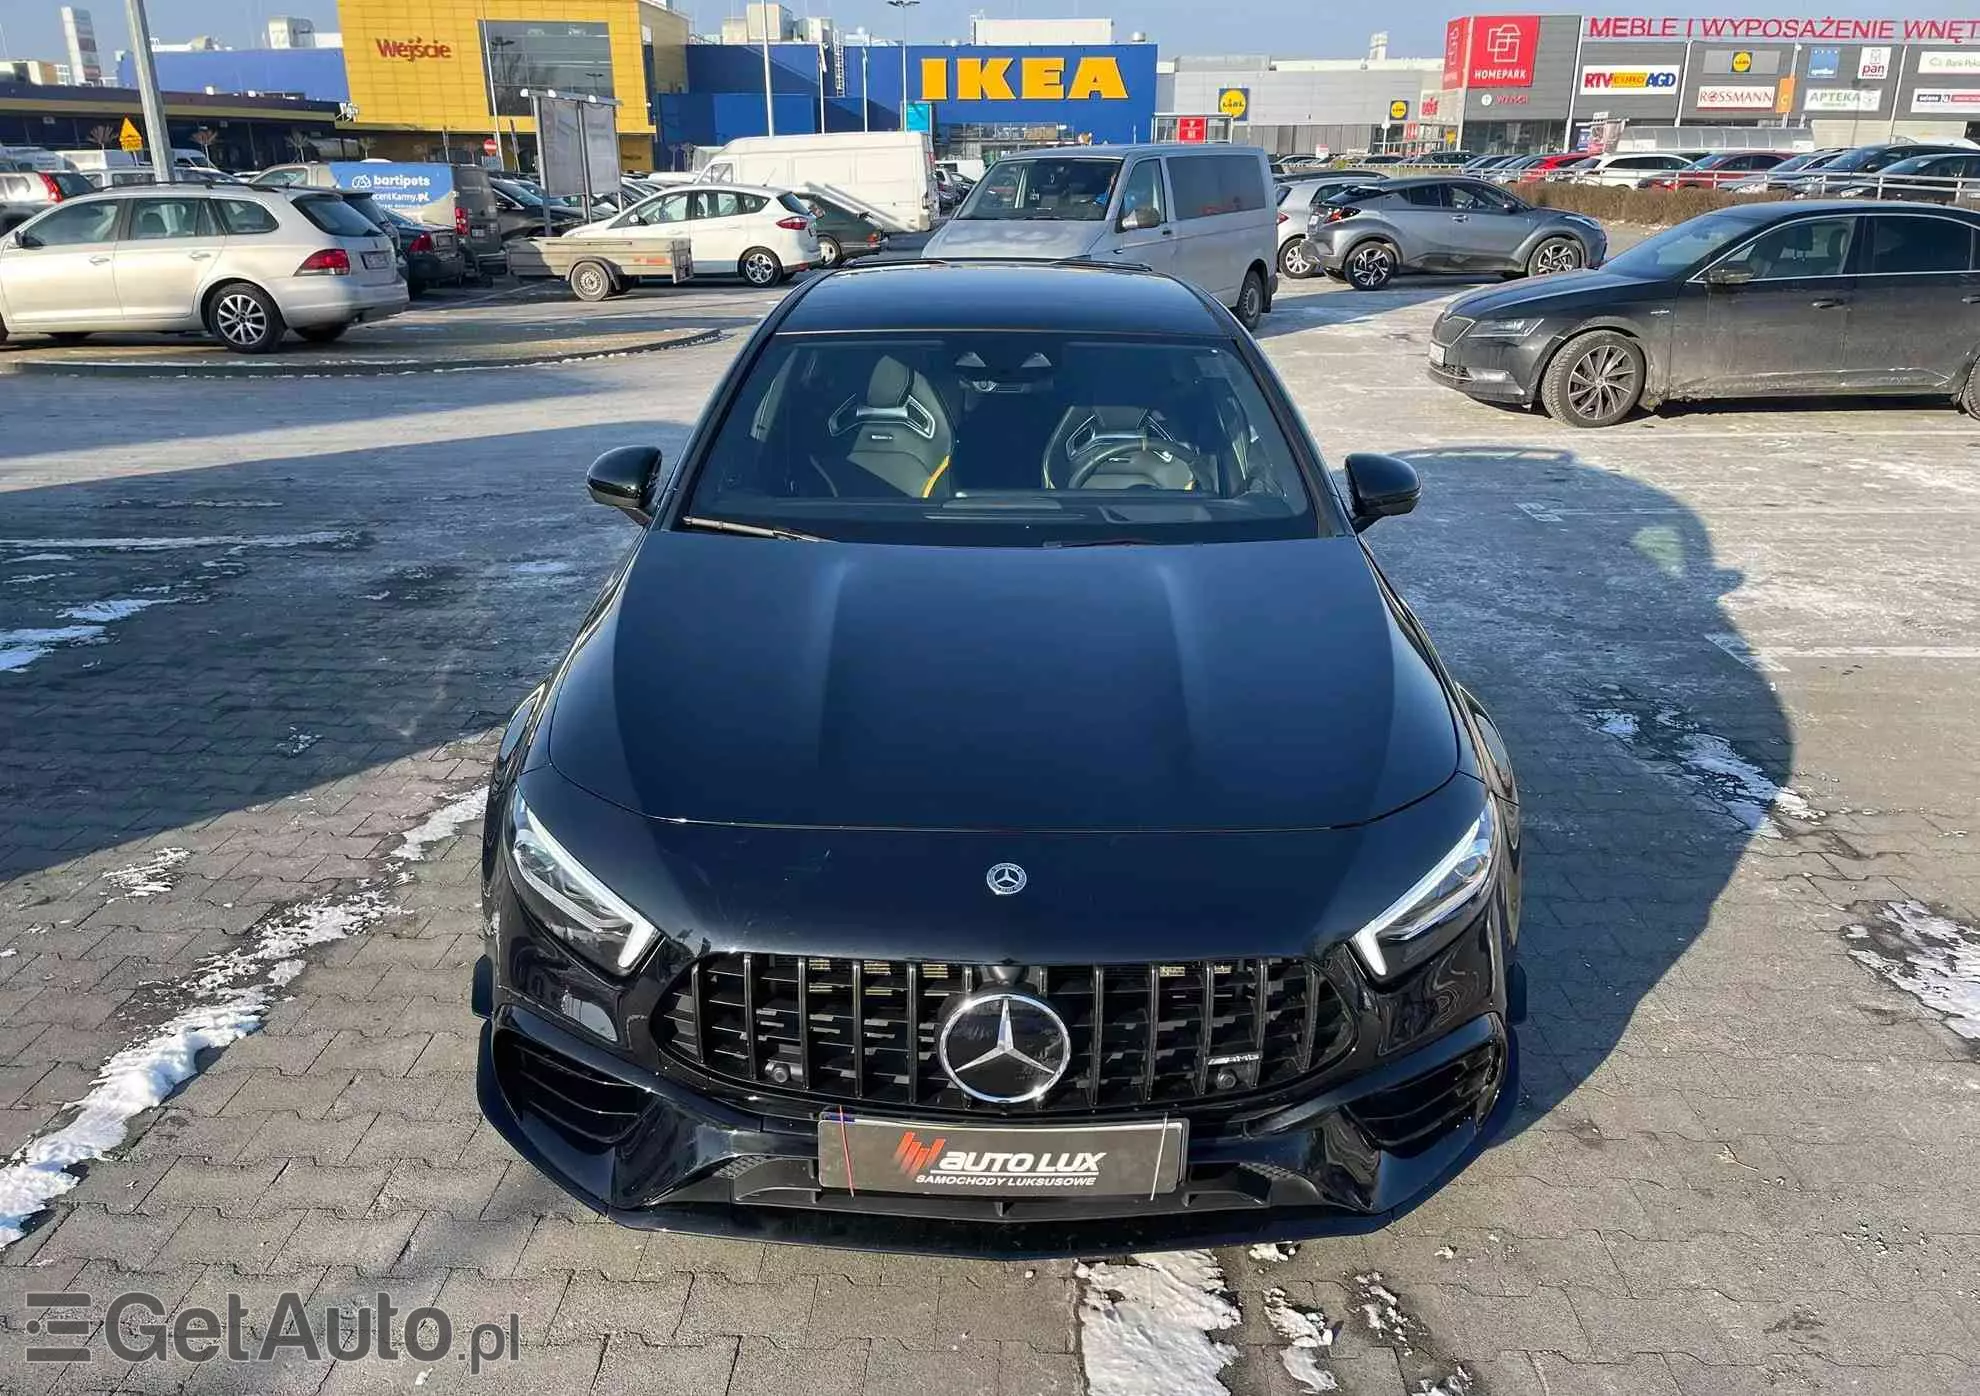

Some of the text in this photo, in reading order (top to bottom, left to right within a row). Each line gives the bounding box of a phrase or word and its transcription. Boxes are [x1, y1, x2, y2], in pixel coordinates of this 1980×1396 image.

[1589, 17, 1680, 38] MEBLE
[1686, 18, 1694, 38] I
[1702, 16, 1894, 39] WYPOSAŻENIE
[376, 37, 451, 62] Wejście
[1474, 69, 1527, 80] HOMEPARK
[1862, 64, 1884, 76] pan
[921, 57, 1129, 100] IKEA
[1584, 73, 1614, 89] RTV
[1646, 72, 1676, 88] AGD
[1700, 91, 1773, 105] ROSSMANN
[1809, 91, 1860, 103] APTEKA
[1045, 1151, 1107, 1173] LUX
[916, 1174, 1097, 1187] SAMOCHODY LUKSUSOWE
